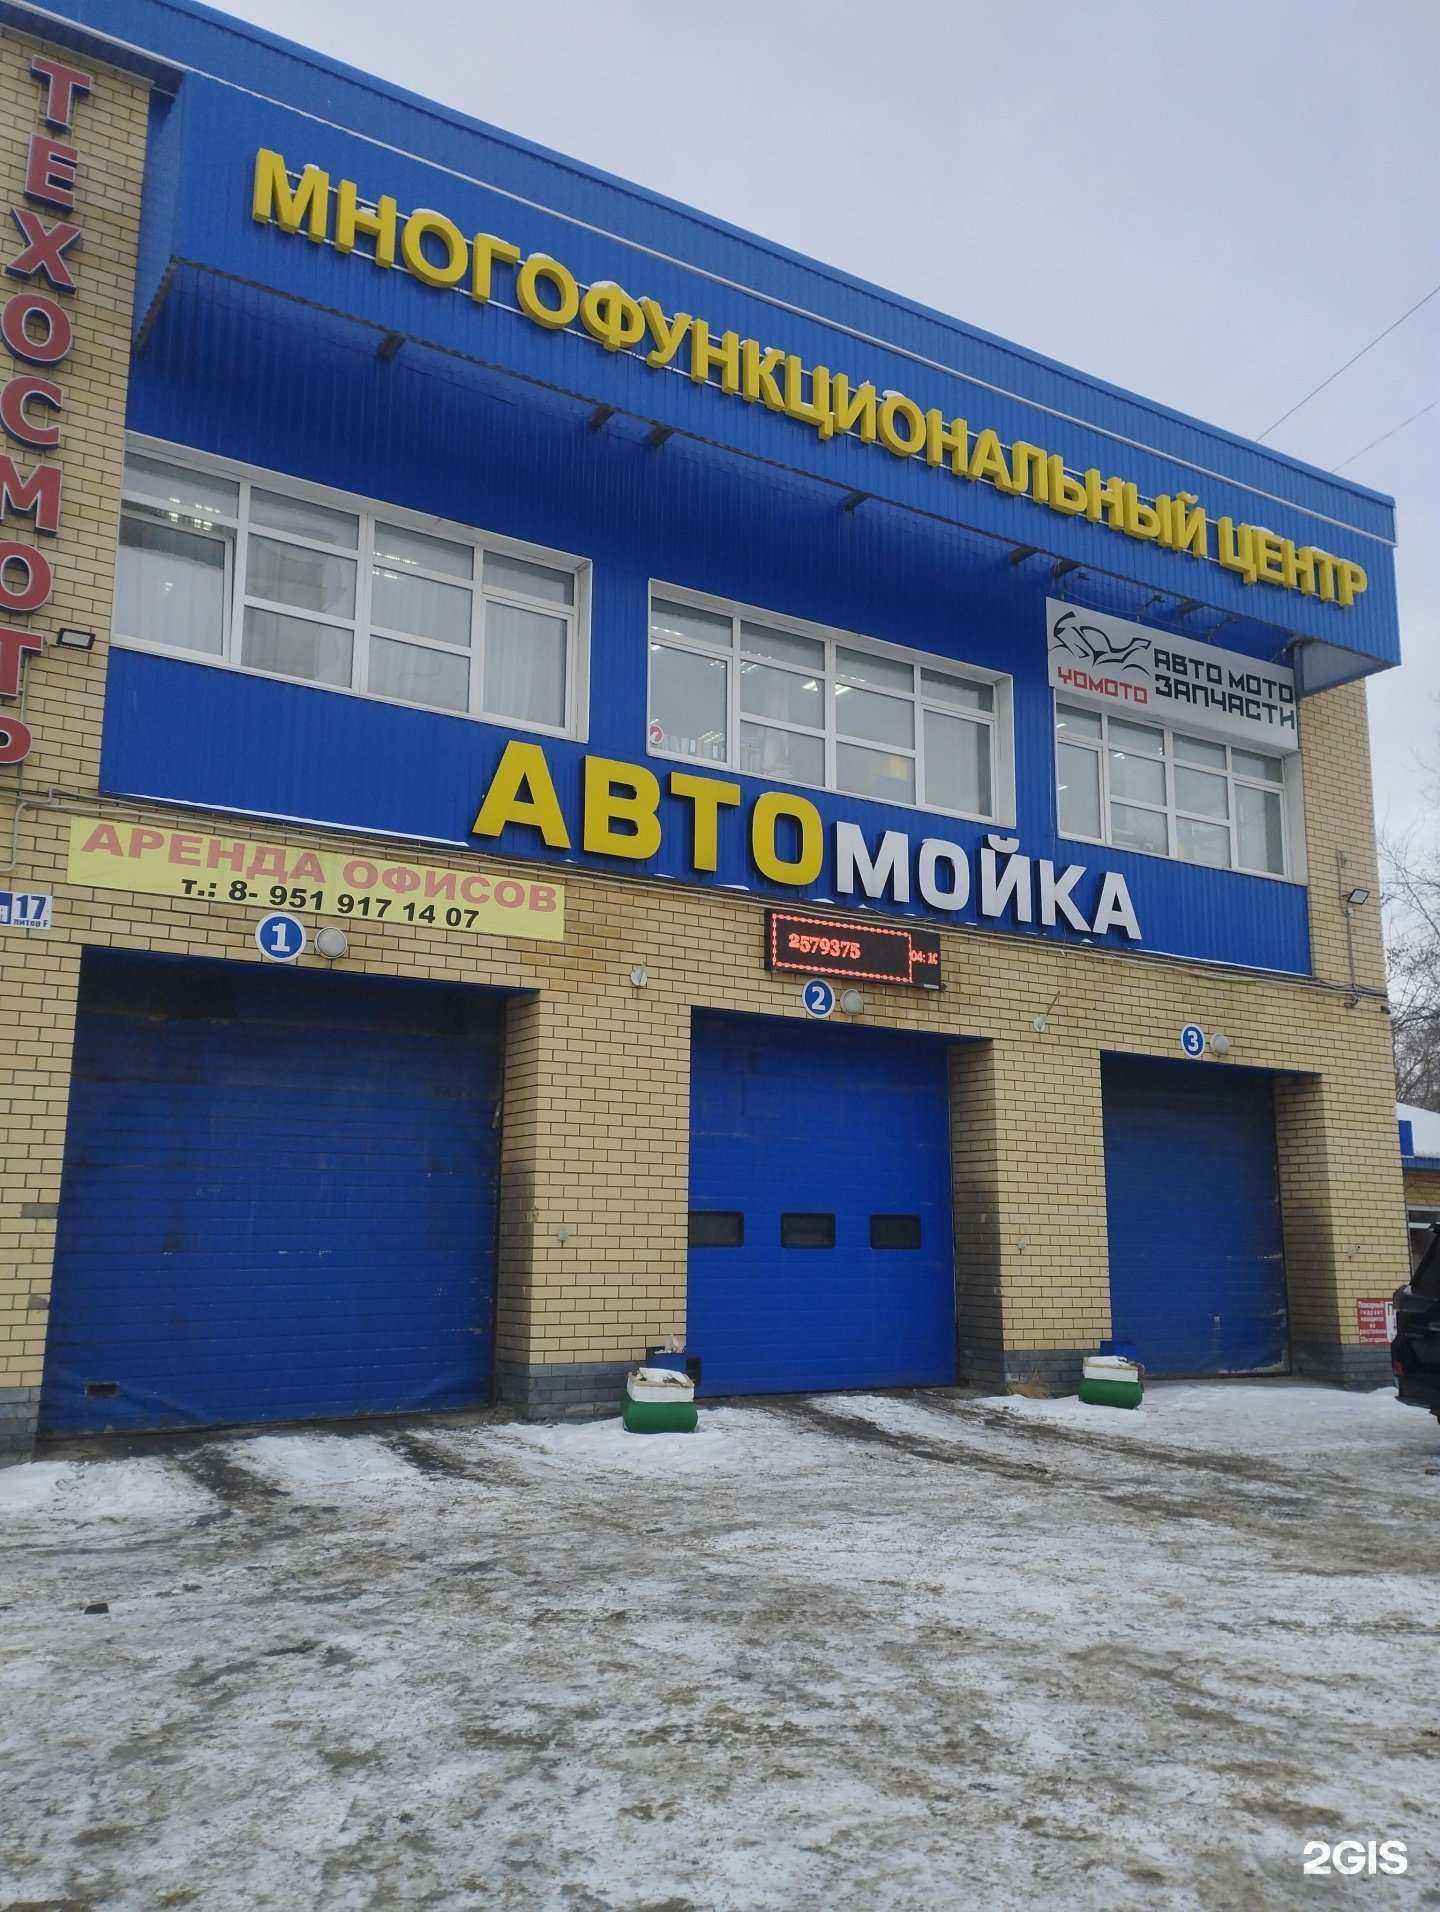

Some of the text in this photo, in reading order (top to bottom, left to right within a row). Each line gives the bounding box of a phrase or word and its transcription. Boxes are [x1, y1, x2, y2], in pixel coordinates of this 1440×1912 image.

[251, 147, 1368, 607] МНОГОФУНКЦИОНАЛЬНЫЙ ЦЕНТР
[1153, 648, 1294, 704] АВТО МОТО
[1154, 673, 1295, 730] ЗАПЧАСТИ
[80, 823, 558, 913] АРЕНДА ОФИСОВ
[16, 895, 46, 919] 17
[269, 885, 325, 911] 951
[337, 893, 392, 918] 917
[403, 902, 436, 924] 14
[445, 907, 480, 929] 07
[270, 922, 291, 953] 1
[788, 932, 862, 960] 2579375
[811, 986, 826, 1011] 2
[1187, 1030, 1199, 1052] 3
